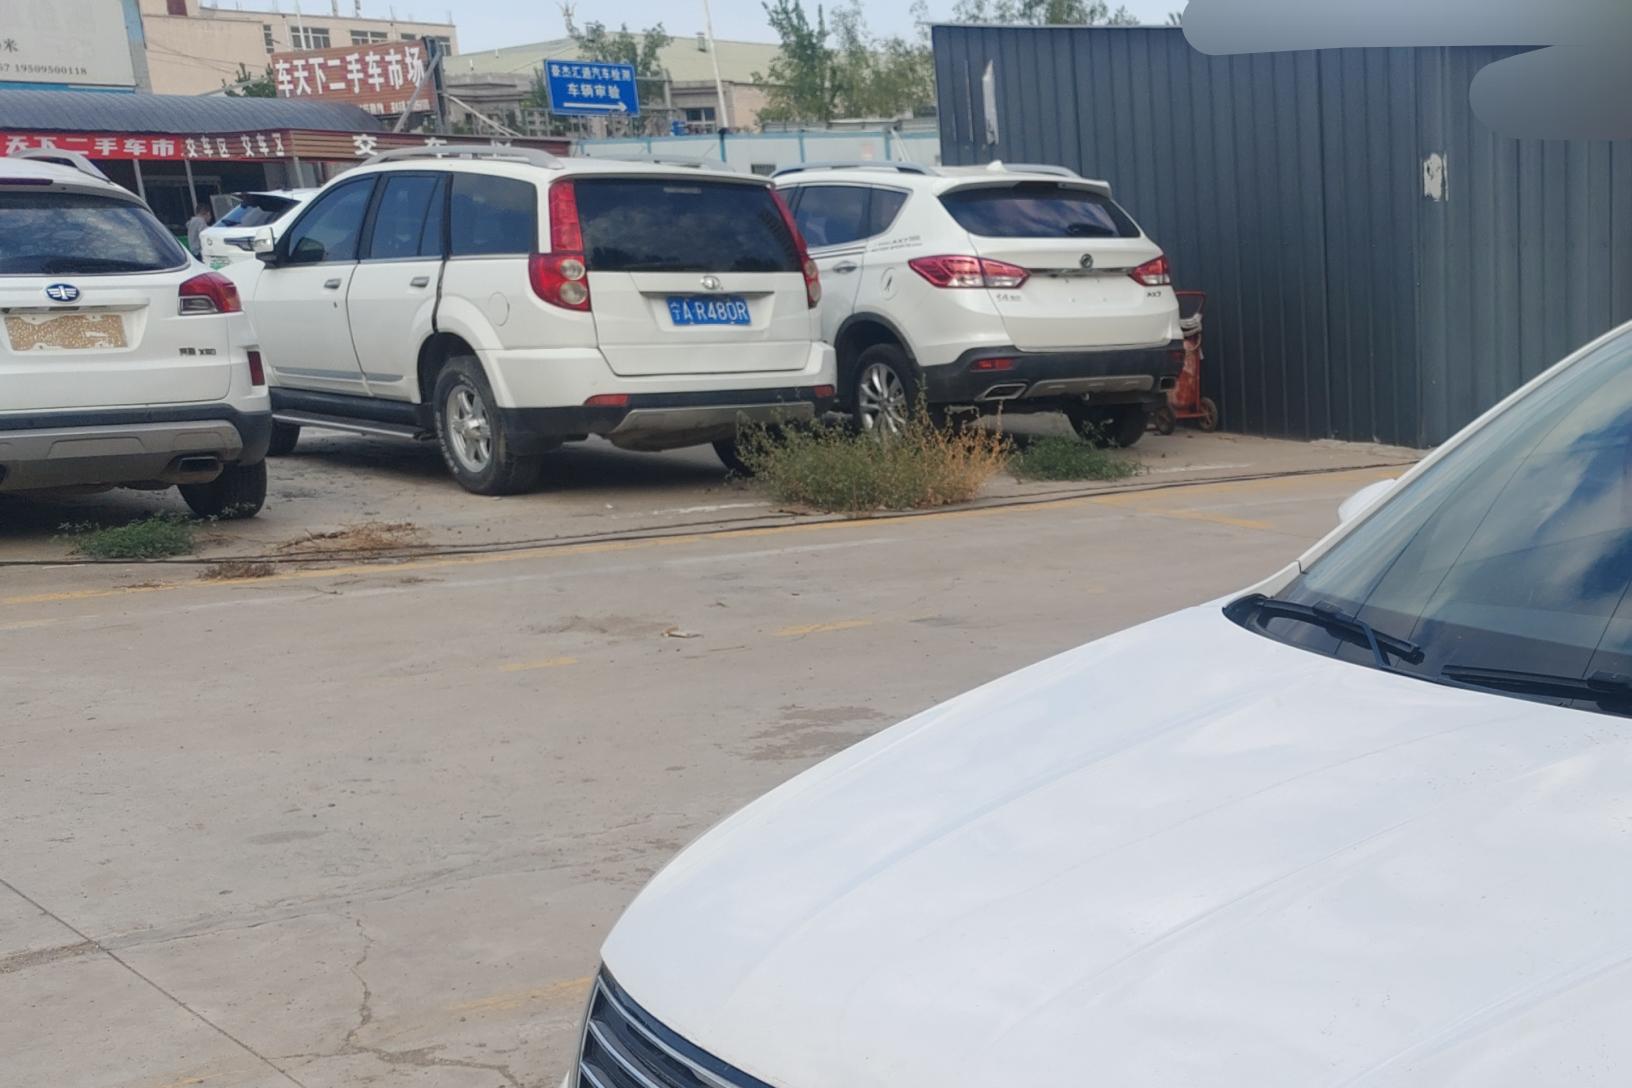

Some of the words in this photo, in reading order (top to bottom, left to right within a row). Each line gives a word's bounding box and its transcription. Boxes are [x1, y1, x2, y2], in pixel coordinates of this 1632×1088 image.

[275, 46, 425, 98] 车天下二手车市场
